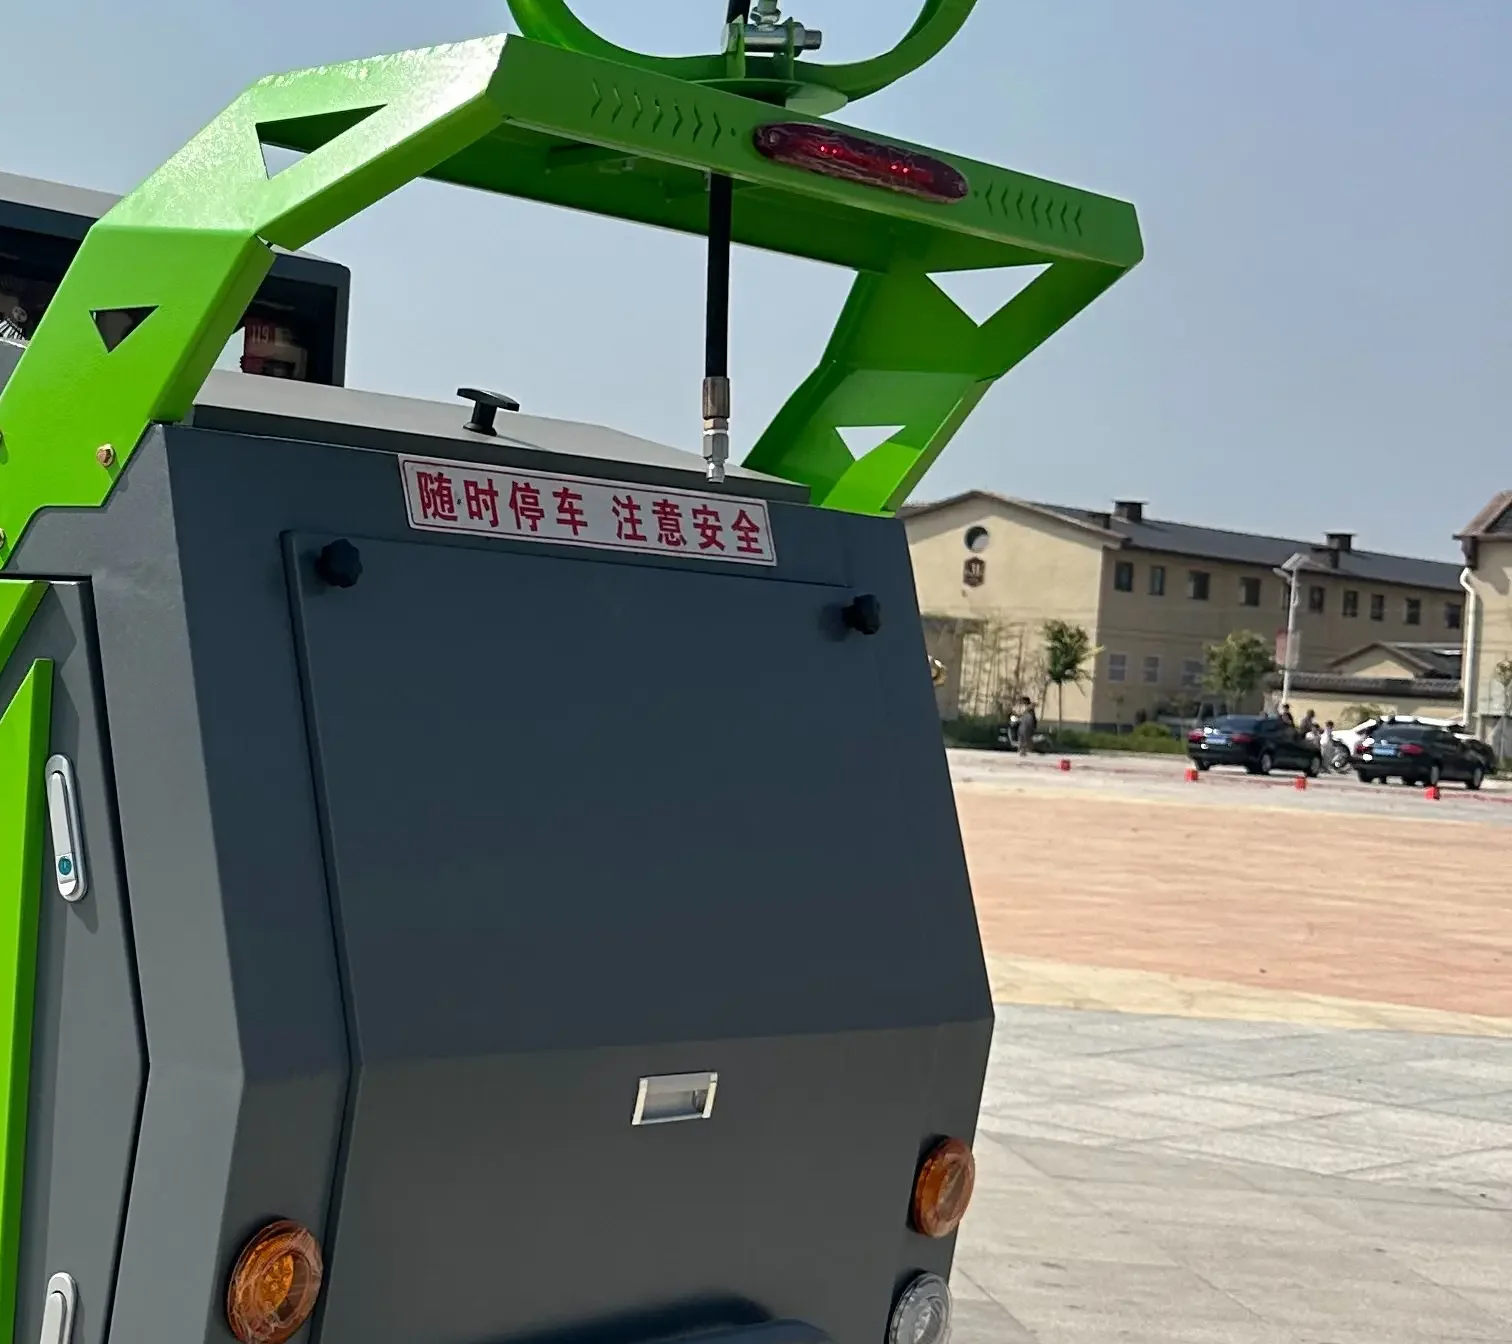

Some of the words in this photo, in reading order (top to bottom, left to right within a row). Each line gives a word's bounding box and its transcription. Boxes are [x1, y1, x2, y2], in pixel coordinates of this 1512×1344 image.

[416, 471, 588, 537] 随时停车
[611, 494, 764, 555] 注意安全
